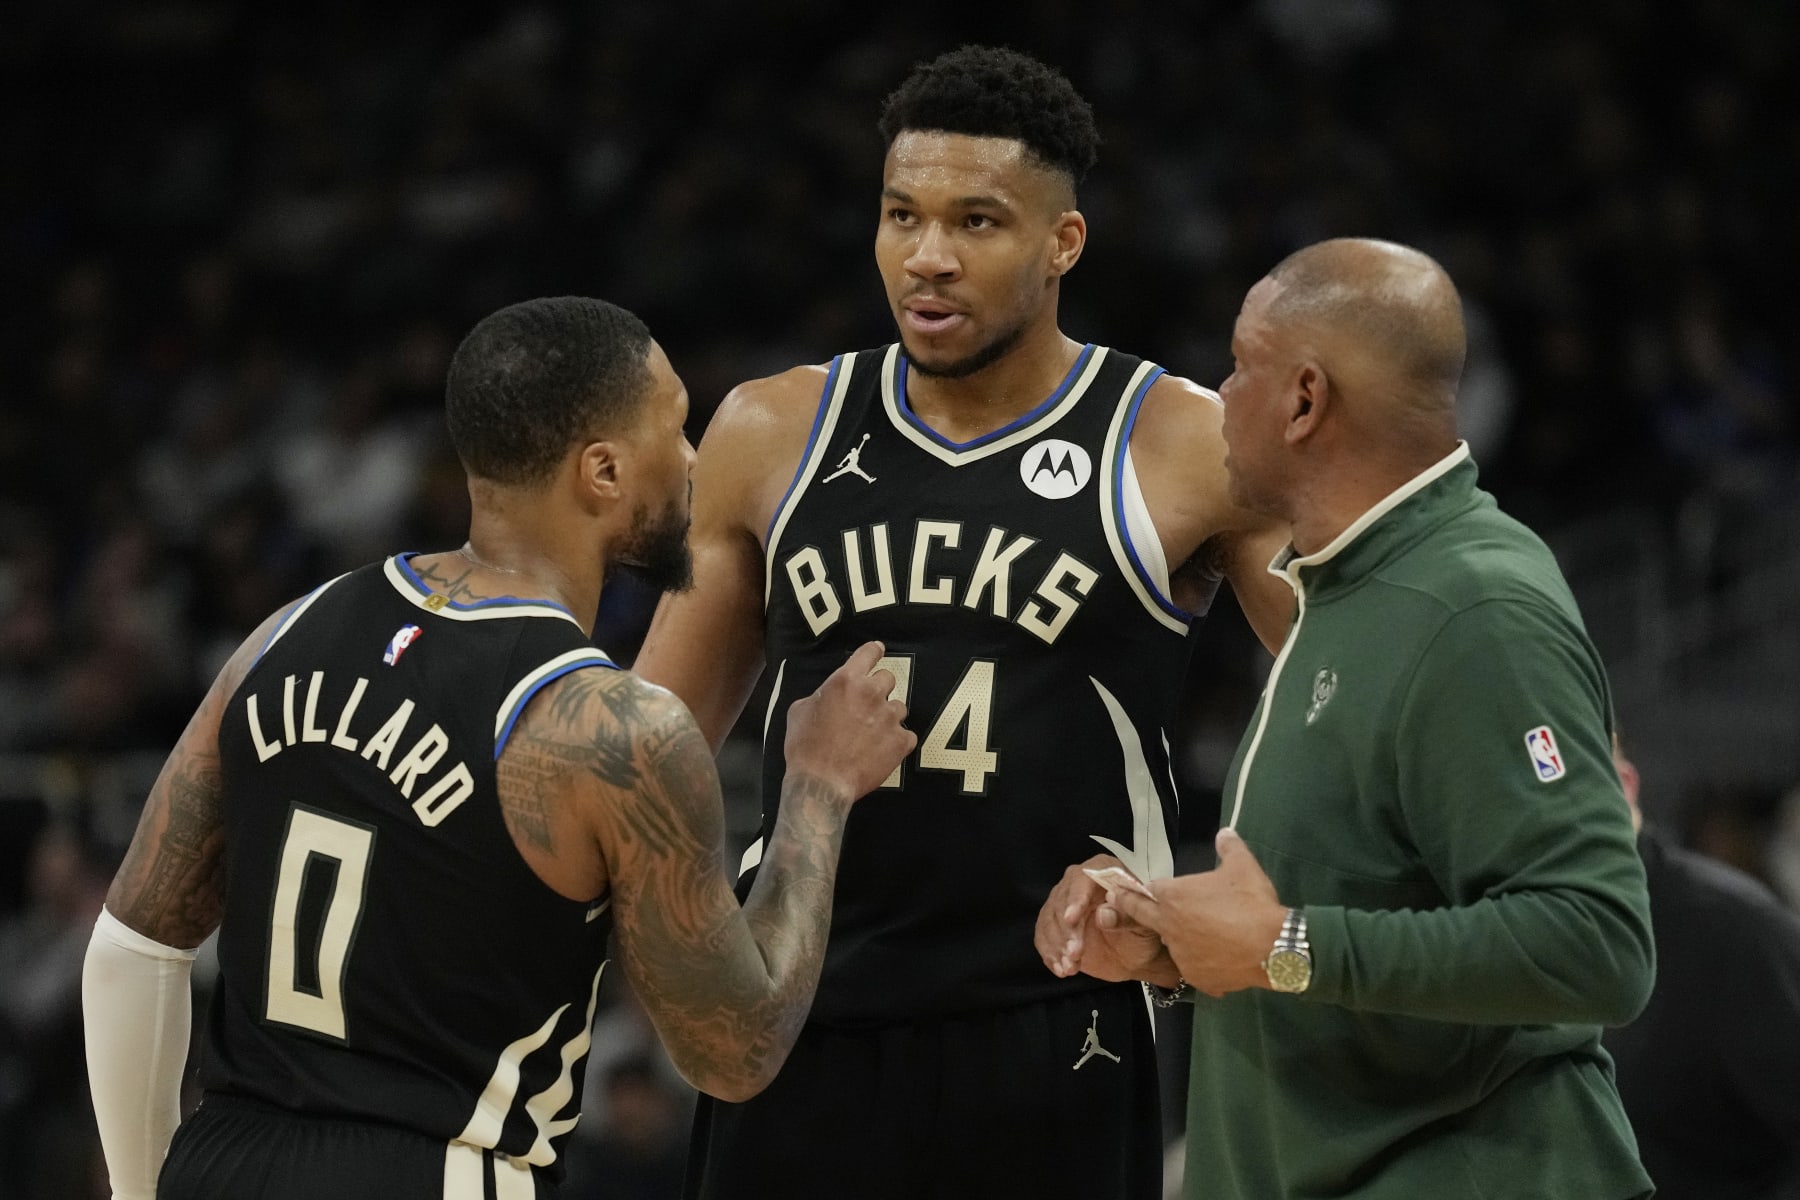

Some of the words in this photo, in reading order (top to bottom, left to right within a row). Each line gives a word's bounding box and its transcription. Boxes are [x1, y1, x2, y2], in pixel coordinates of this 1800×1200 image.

[785, 519, 1100, 646] BUCKS
[246, 670, 475, 827] LILLARD
[264, 806, 375, 1042] 0
